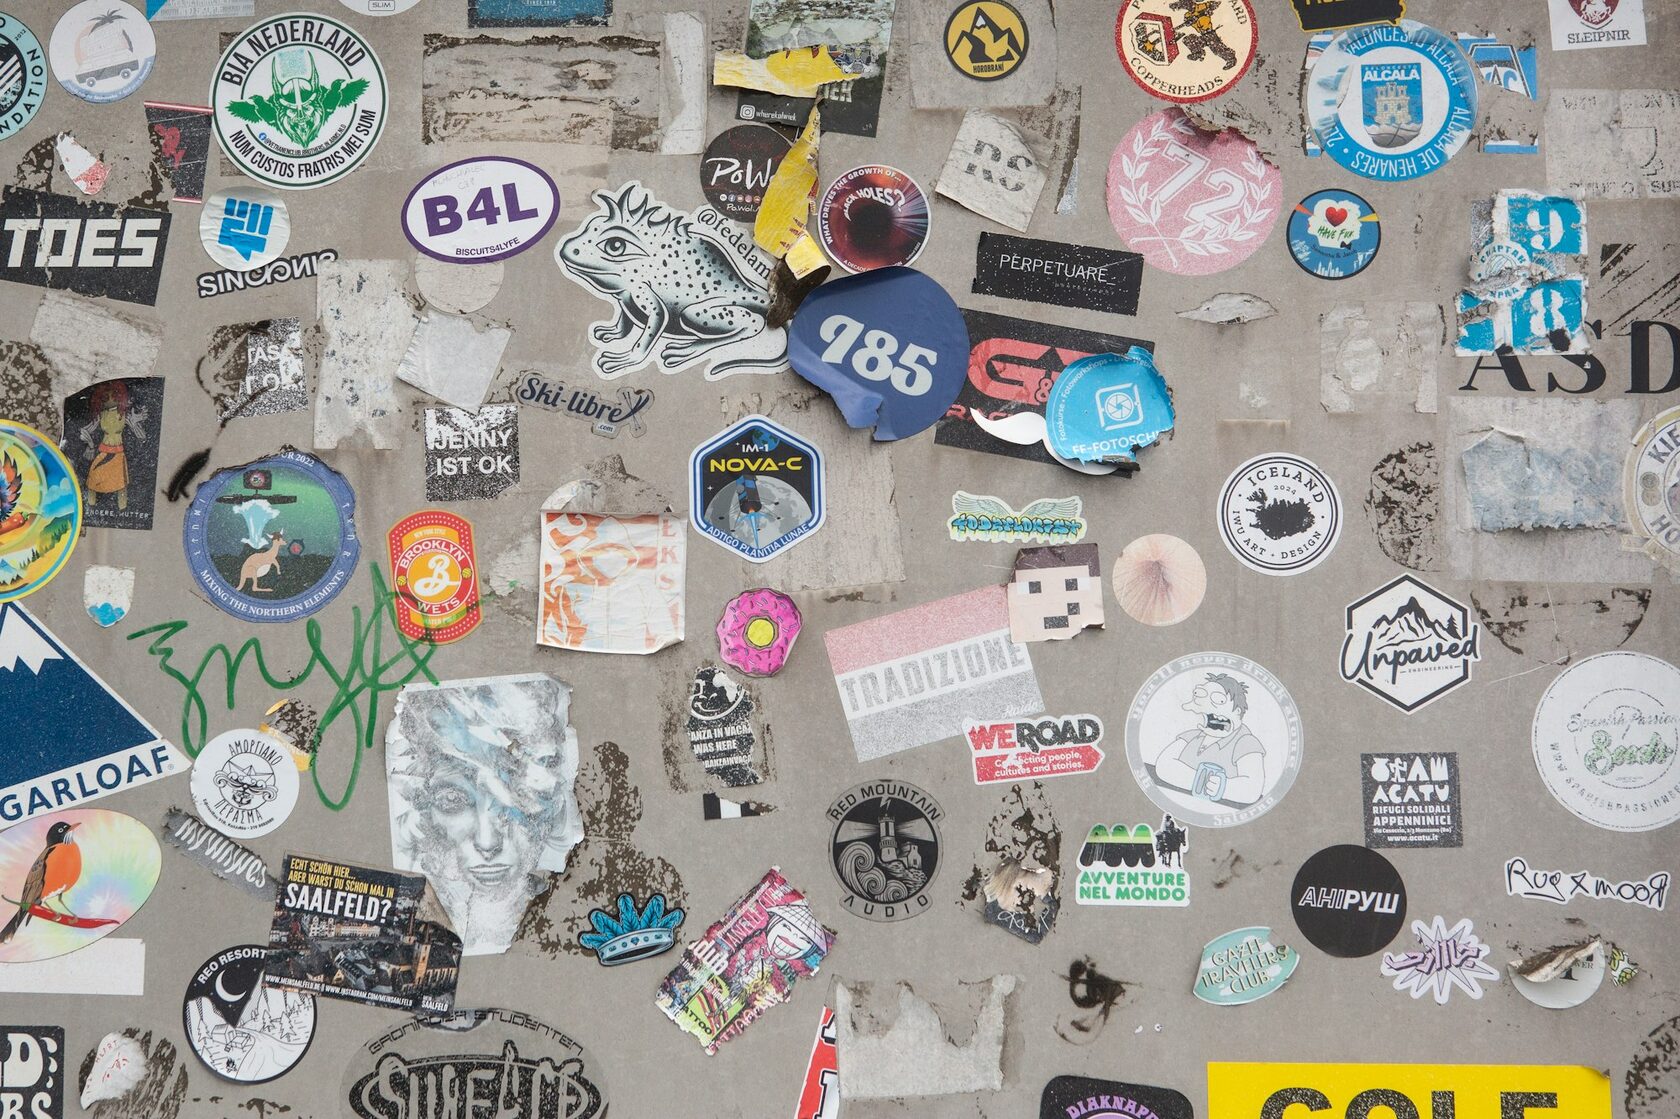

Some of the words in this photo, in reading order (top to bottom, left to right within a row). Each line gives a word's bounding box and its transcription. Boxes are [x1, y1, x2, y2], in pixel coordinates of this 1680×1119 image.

[1567, 29, 1631, 45] SLEIPNIR
[221, 52, 253, 87] BIA
[247, 20, 366, 67] NEDERLAND
[1130, 57, 1224, 96] COPPERHEADS
[229, 130, 252, 158] NUM
[250, 152, 294, 178] CUSTOS
[298, 152, 346, 179] FRATRIS
[343, 135, 366, 158] MEI
[358, 109, 377, 140] SUM
[1351, 151, 1417, 177] HENARES
[1419, 150, 1440, 171] DE
[834, 178, 848, 191] THE
[848, 168, 884, 180] GROWTH
[1148, 139, 1249, 228] 72
[422, 183, 539, 236] B4L
[822, 192, 836, 218] DRIVES
[822, 221, 833, 245] WHAT
[455, 238, 521, 256] BISCUITS4LYFE
[819, 314, 937, 397] 985
[296, 453, 315, 467] 2022
[741, 443, 769, 454] IM-1
[436, 456, 473, 477] IST
[479, 454, 516, 475] OK
[710, 457, 803, 473] NOVA-C
[1247, 466, 1325, 503] ICELAND
[1273, 484, 1297, 495] 2024
[706, 524, 740, 550] ADTIGO
[739, 537, 784, 558] PLANITIA
[779, 523, 811, 550] LUNAE
[1232, 510, 1245, 535] IWU
[1243, 537, 1267, 555] ART
[1280, 530, 1323, 559] DESIGN
[400, 540, 465, 569] BROOKLYN
[201, 570, 227, 601] MIXING
[228, 597, 247, 611] THE
[249, 602, 304, 617] NORTHERN
[304, 569, 345, 609] ELEMENTS
[418, 597, 460, 614] WETS
[1341, 624, 1478, 685] Unpaved
[841, 637, 1026, 712] TRADIZIONE
[228, 739, 283, 766] ΑΜΟΡΓΙΑΝΟ
[693, 742, 714, 754] WAS
[715, 739, 738, 750] HERE
[1048, 752, 1083, 764] people,
[1033, 762, 1051, 773] and
[213, 799, 263, 824] ΠΕΡΑΣΜΑ
[831, 794, 857, 821] RED
[861, 784, 941, 821] MOUNTAIN
[1372, 805, 1405, 814] RIFUGI
[1407, 804, 1450, 814] SOLIDALI
[1373, 815, 1451, 826] APPENNINICI
[1387, 834, 1439, 842] www.acatu.it
[290, 858, 309, 871] ECHT
[288, 872, 307, 883] ABER
[307, 874, 333, 887] WARST
[334, 878, 344, 889] DU
[369, 884, 386, 896] MAL
[1080, 871, 1186, 887] AVVENTURE
[284, 884, 392, 923] SAALFELD?
[844, 894, 928, 918] AUDIO
[1079, 886, 1111, 900] NEL
[1115, 886, 1186, 902] MONDO
[198, 961, 218, 985] REO
[1203, 945, 1288, 987] TRAVELERS
[1231, 971, 1270, 993] CLUB
[421, 1000, 448, 1012] SAALFELD
